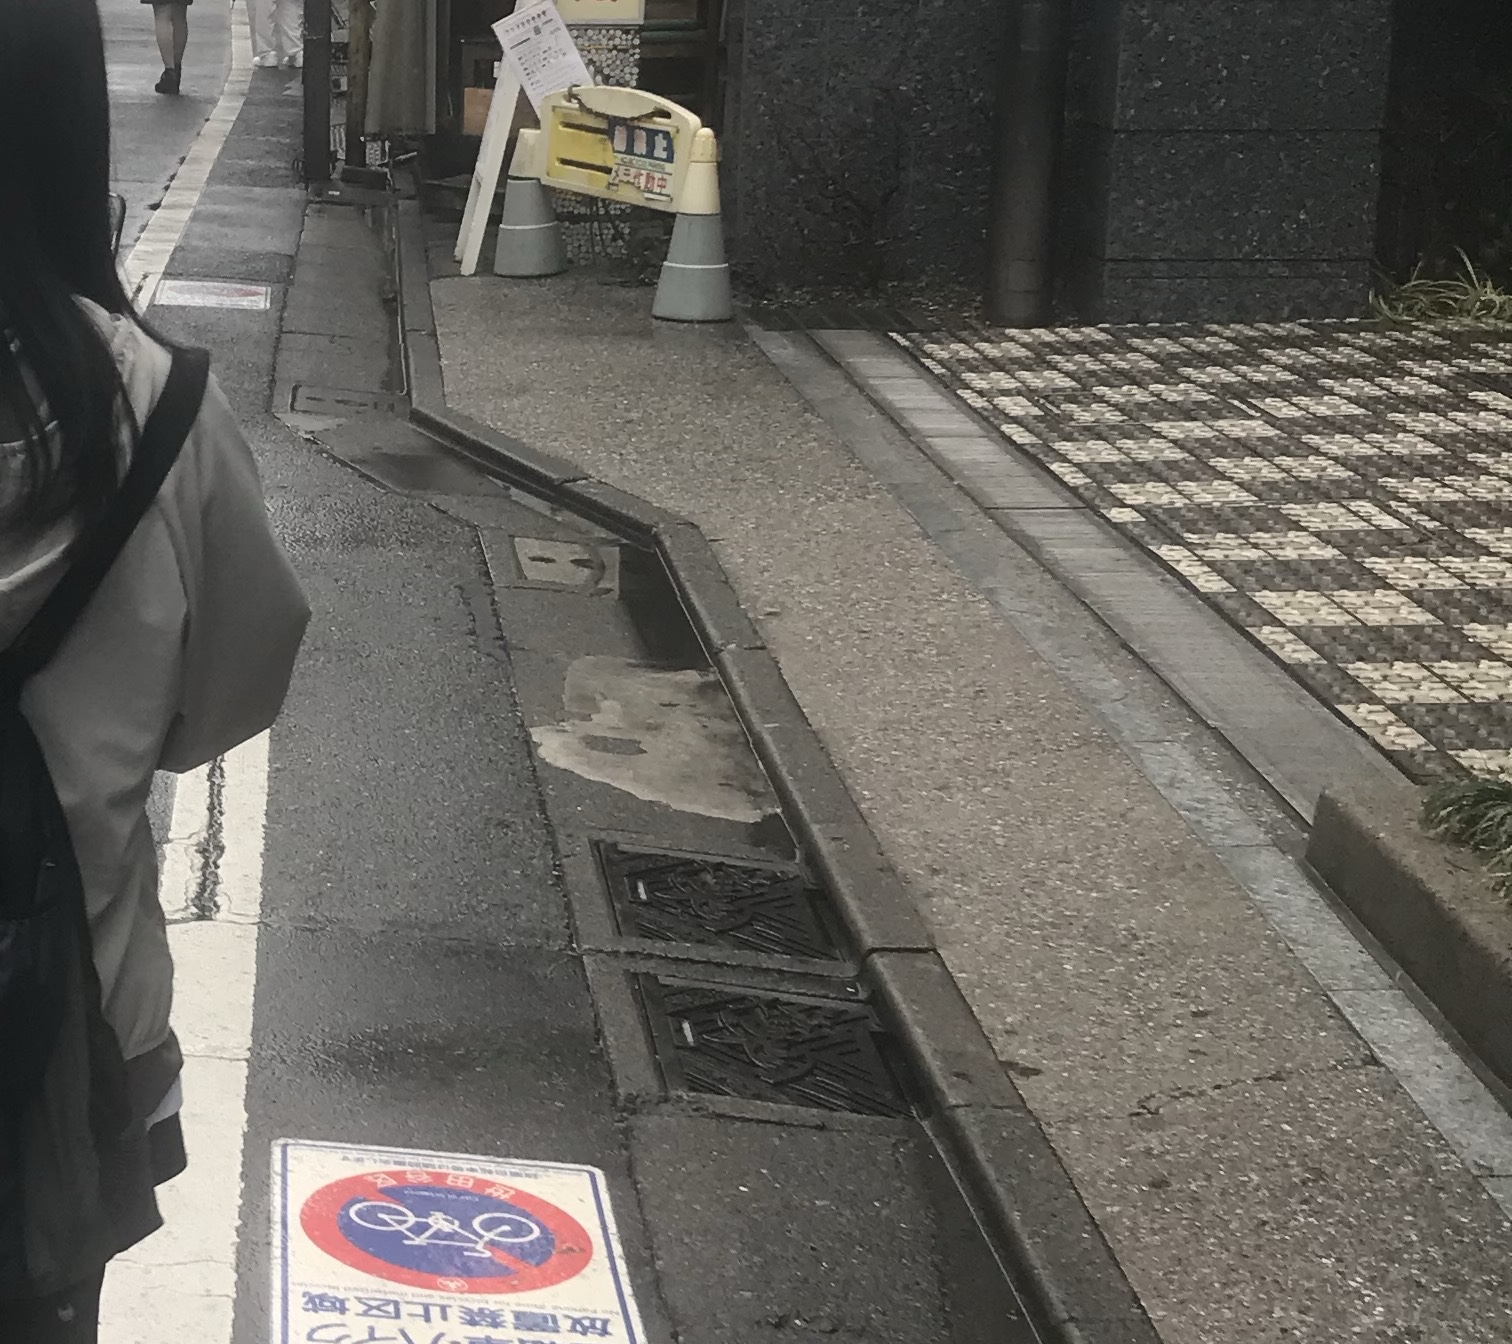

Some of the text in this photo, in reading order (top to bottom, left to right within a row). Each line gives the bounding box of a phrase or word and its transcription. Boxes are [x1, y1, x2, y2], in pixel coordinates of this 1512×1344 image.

[364, 1169, 516, 1199] 世田谷区
[302, 1291, 613, 1337] 放置禁止区域
